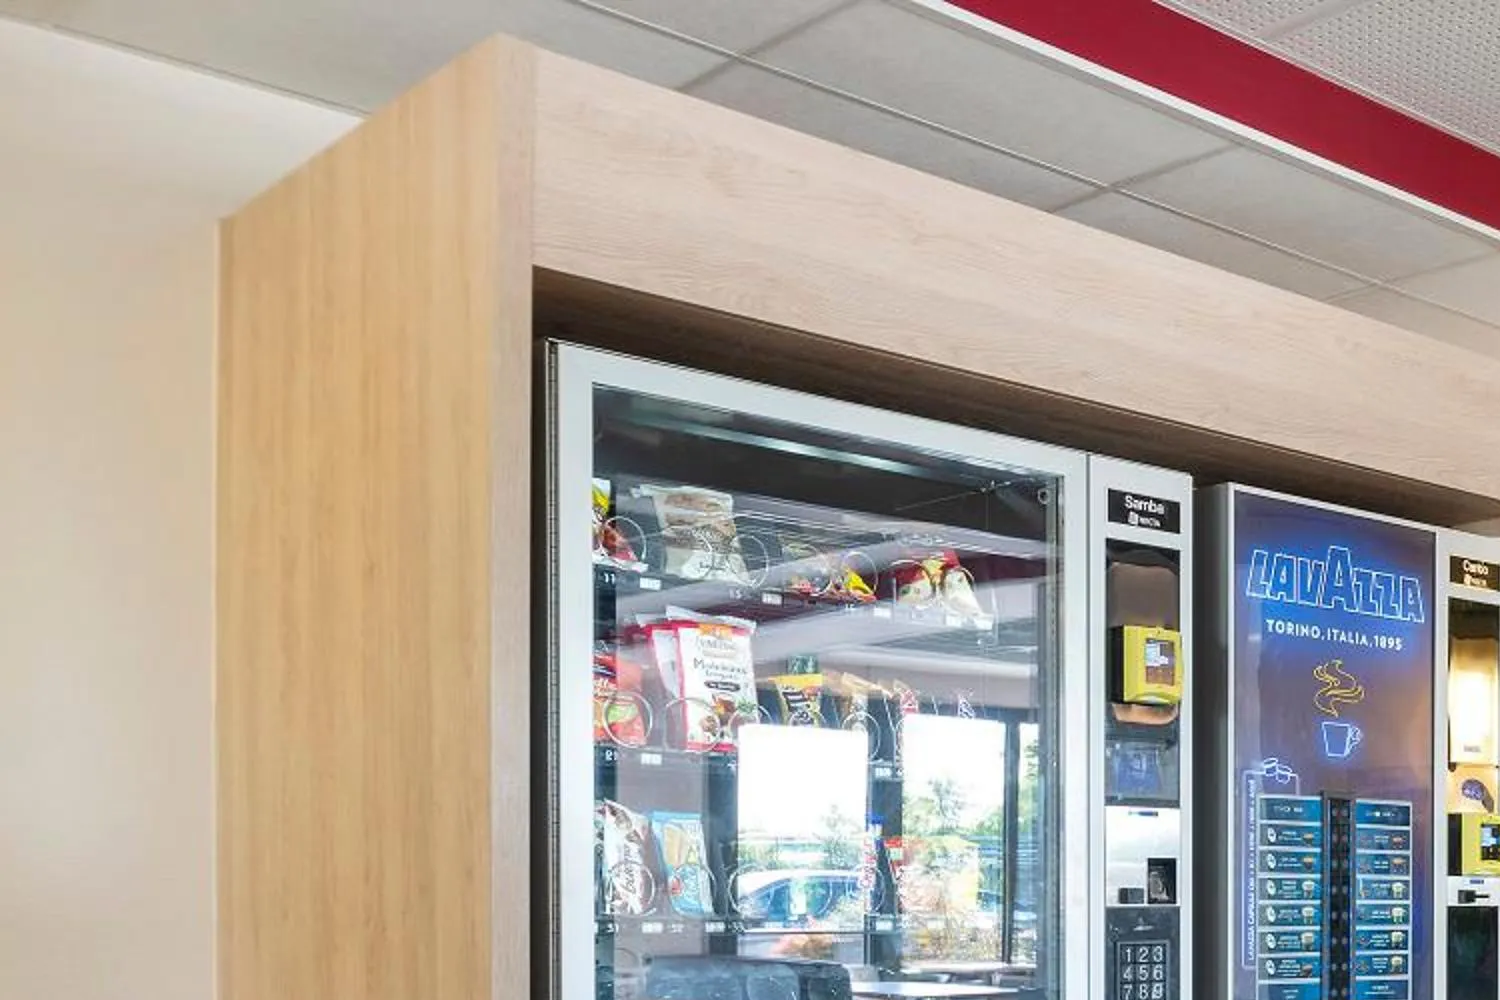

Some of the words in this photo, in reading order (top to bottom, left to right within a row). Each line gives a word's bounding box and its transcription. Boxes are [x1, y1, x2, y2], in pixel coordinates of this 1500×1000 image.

[1246, 544, 1425, 624] LAVAZZA
[1374, 635, 1402, 651] 1895
[1126, 947, 1132, 962] 1
[1139, 947, 1149, 963] 2
[1152, 945, 1163, 962] 3
[1123, 967, 1132, 981] 4
[1139, 966, 1149, 981] 5
[1153, 964, 1163, 980] 6
[1123, 985, 1132, 1000] 7
[1139, 984, 1149, 1000] 8
[1152, 983, 1163, 1000] 9
